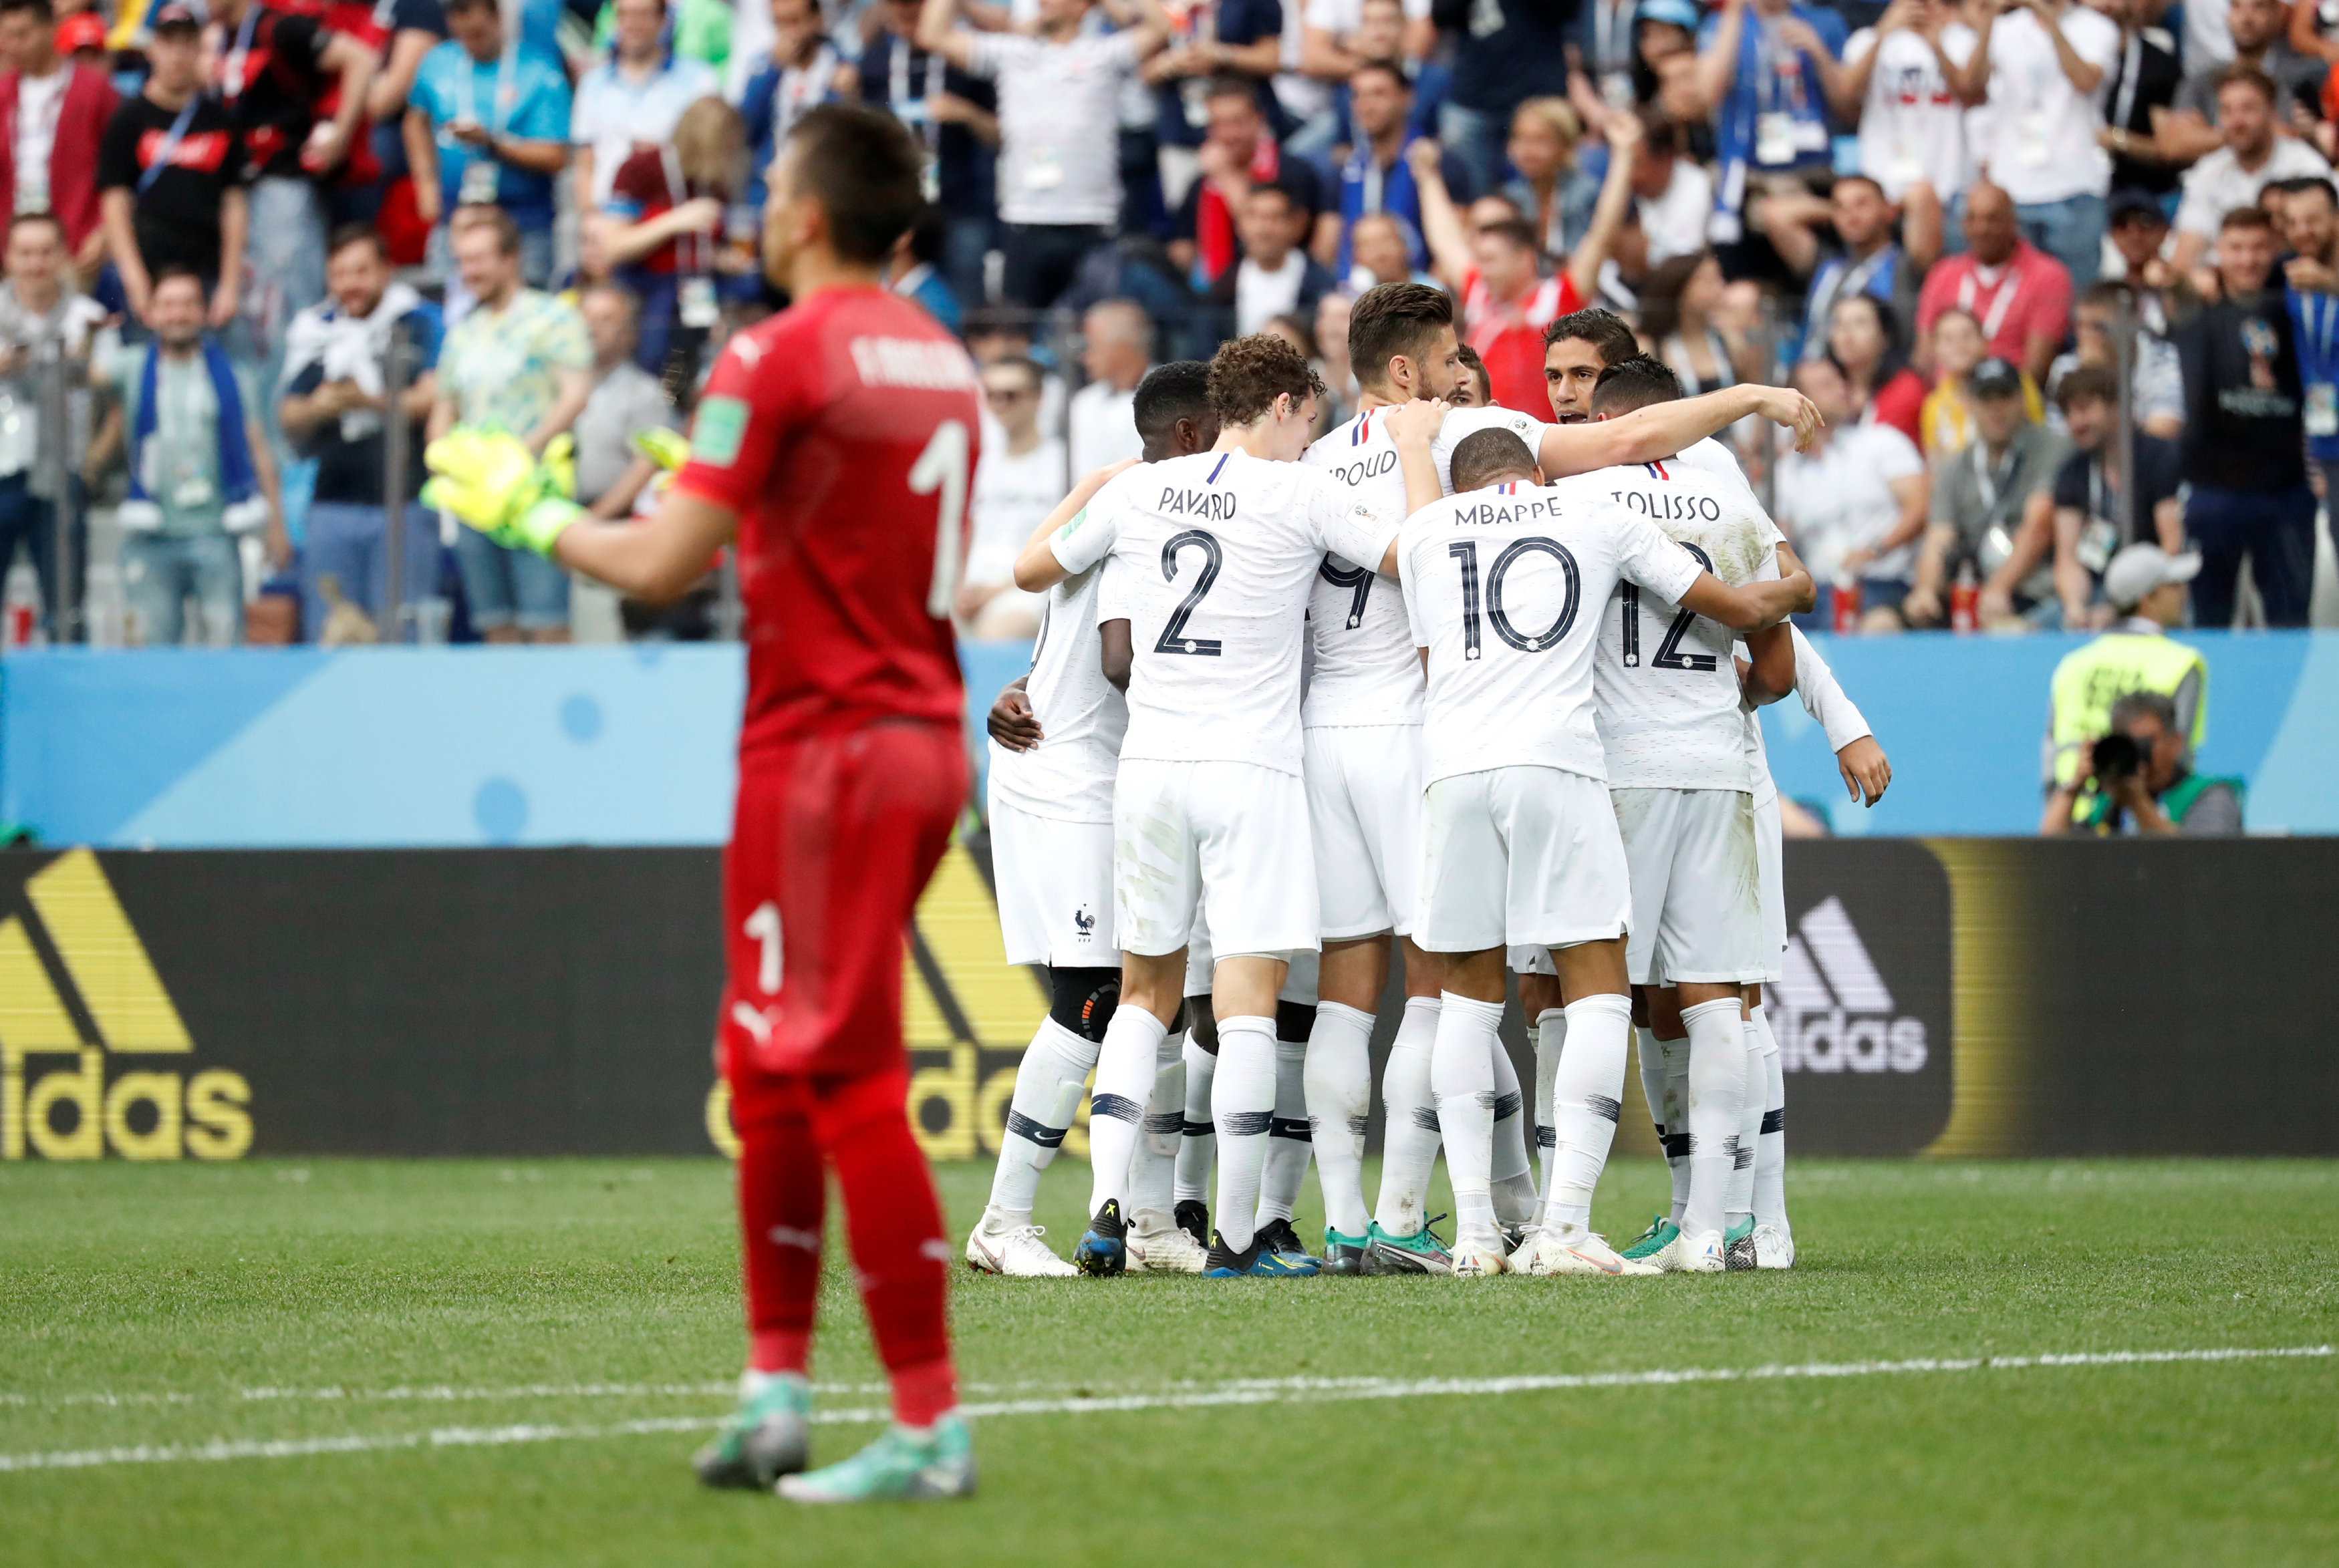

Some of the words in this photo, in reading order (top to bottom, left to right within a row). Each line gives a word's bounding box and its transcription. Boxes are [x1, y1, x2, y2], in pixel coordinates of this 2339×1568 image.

[908, 417, 968, 619] 1
[1157, 487, 1236, 521] PAVARD
[1329, 450, 1397, 486] ROUD
[1455, 496, 1562, 526] MBAPPE
[1153, 530, 1223, 656] 2
[1448, 536, 1581, 661] 10
[1622, 541, 1716, 671] 12
[743, 900, 784, 995] 1
[1772, 1007, 1929, 1073] idas
[0, 1044, 255, 1160] idas
